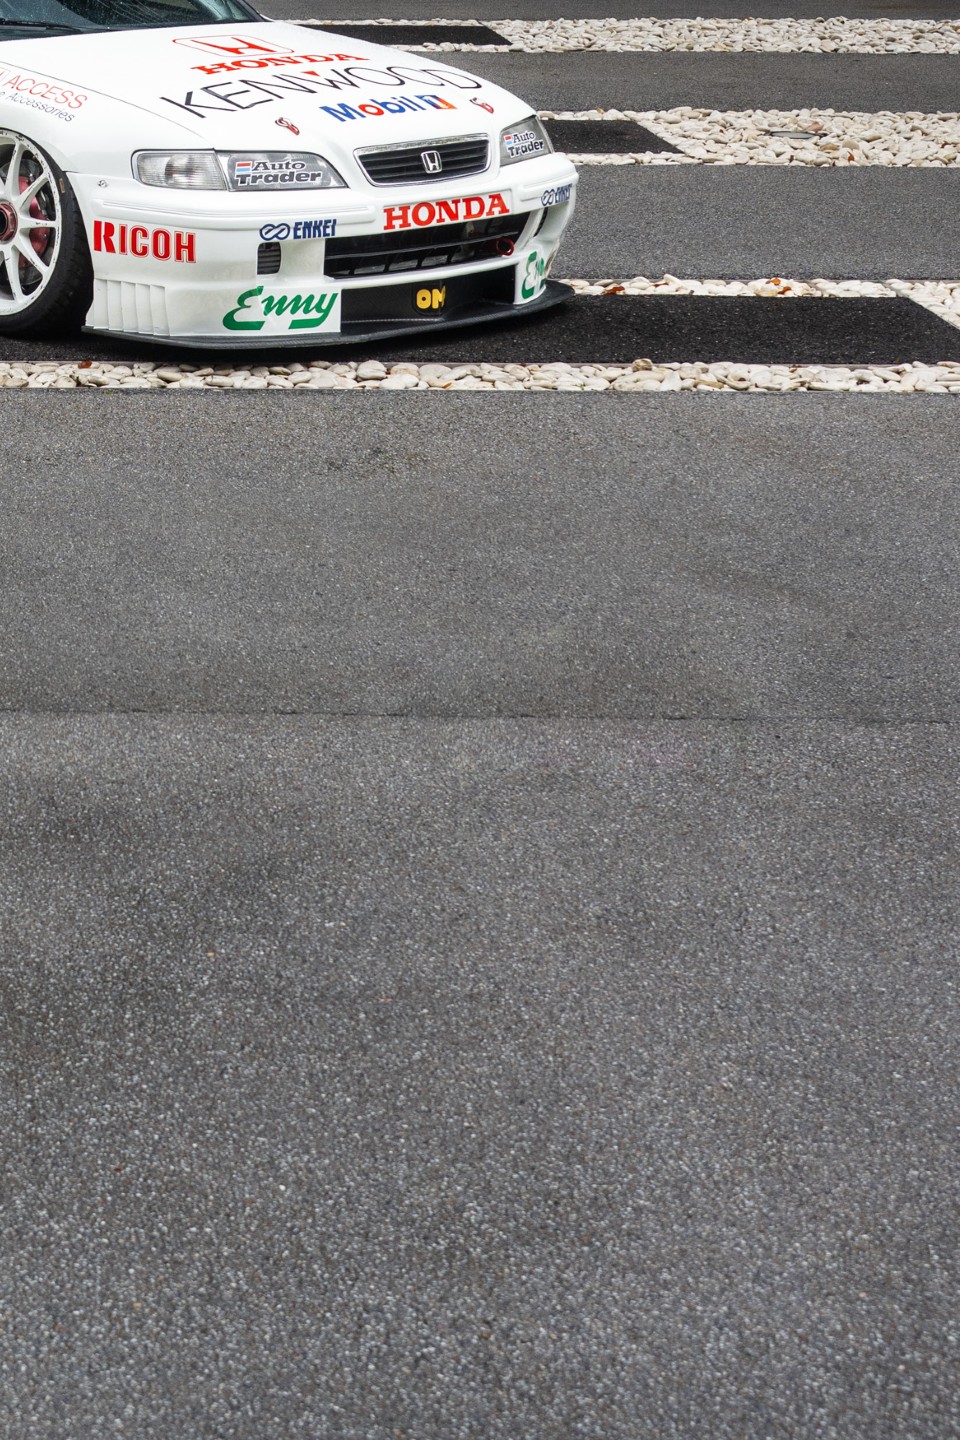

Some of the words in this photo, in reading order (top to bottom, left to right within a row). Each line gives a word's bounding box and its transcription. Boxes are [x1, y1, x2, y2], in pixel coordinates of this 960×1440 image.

[190, 53, 370, 74] HONDA
[3, 75, 88, 109] ACCESS
[159, 66, 482, 118] KENWOOD
[6, 92, 75, 122] Accessories
[319, 96, 425, 122] Mobil
[508, 140, 545, 157] Trader
[512, 131, 535, 144] Auto
[236, 171, 322, 186] Trader
[251, 160, 306, 171] Auto
[383, 193, 510, 231] HONDA
[93, 220, 196, 263] RICOH
[293, 219, 337, 240] ENKEI
[222, 286, 339, 331] Enny
